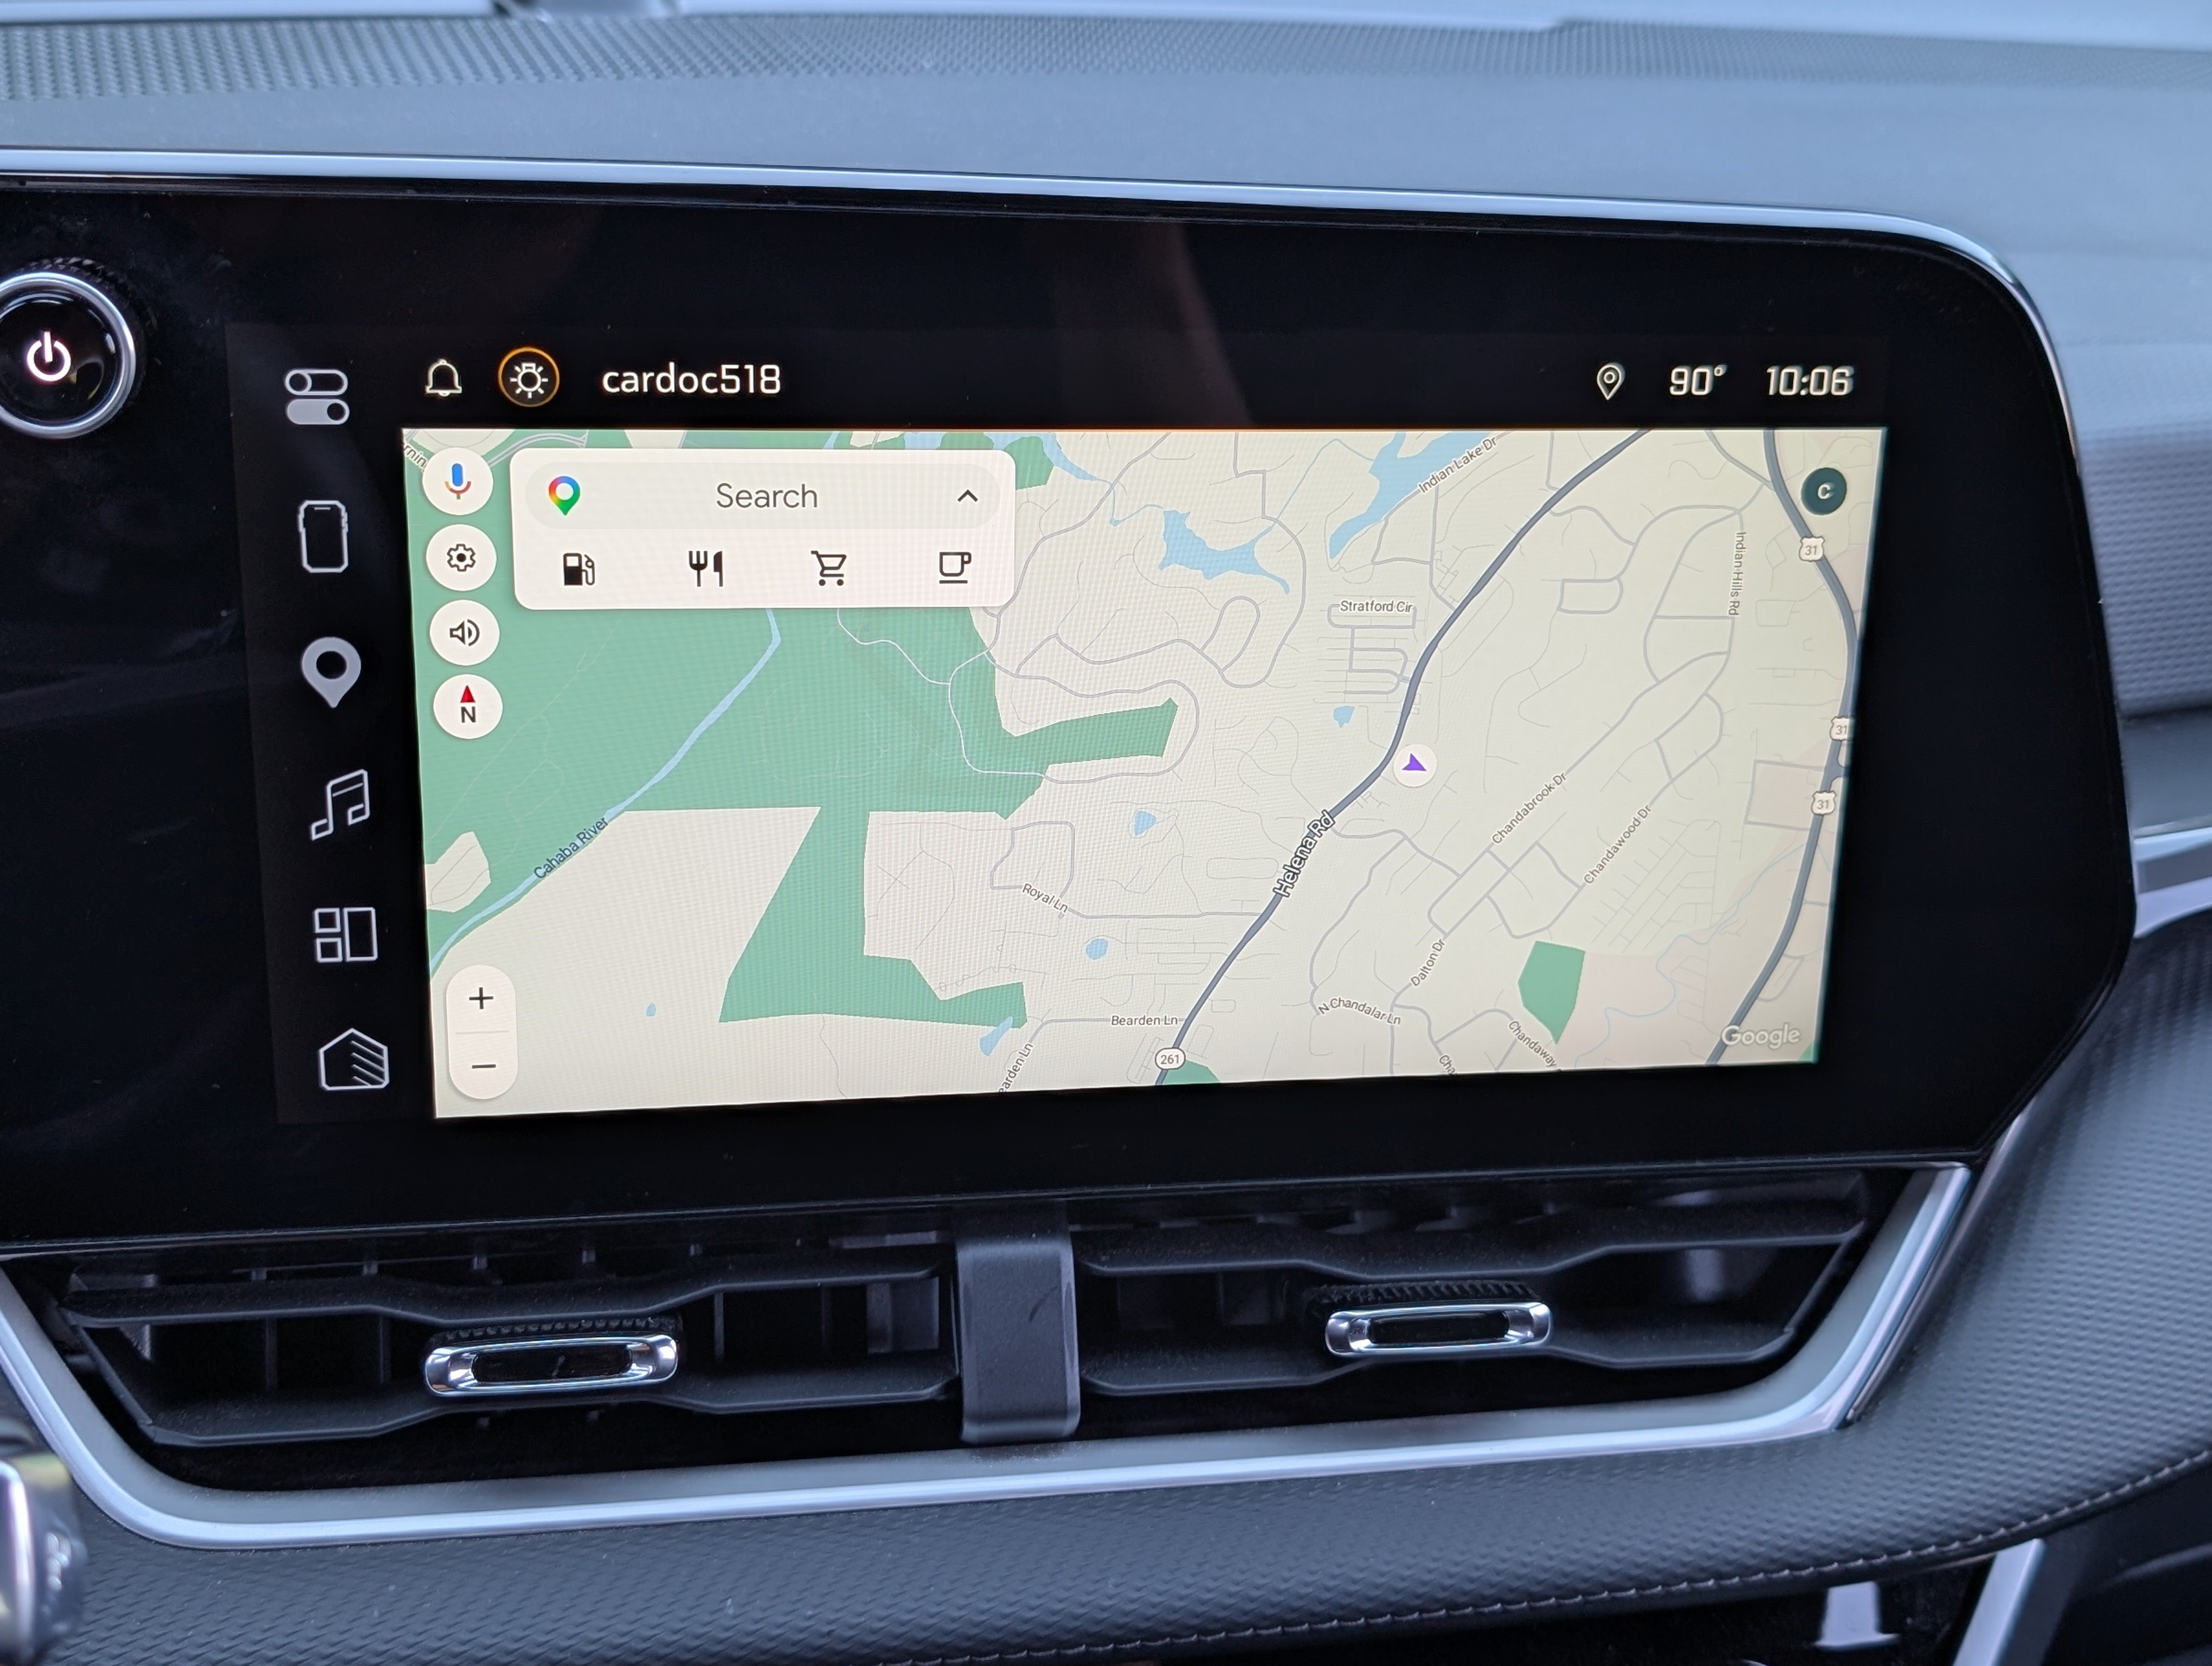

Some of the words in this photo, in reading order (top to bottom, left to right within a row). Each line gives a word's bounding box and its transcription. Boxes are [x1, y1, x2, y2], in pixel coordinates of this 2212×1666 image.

[602, 362, 781, 394] cardoc518
[1766, 365, 1854, 396] 10:06
[404, 445, 427, 472] rnin
[1418, 465, 1454, 493] Indian
[1453, 447, 1483, 470] Lake
[1482, 437, 1496, 451] Dr
[716, 483, 818, 509] Search
[1734, 532, 1746, 568] Indian
[1805, 545, 1817, 556] 31
[1731, 572, 1743, 598] Hills
[1340, 600, 1394, 612] Stratford
[1397, 601, 1413, 613] Cir
[1728, 600, 1740, 616] Rd
[460, 706, 476, 723] N
[1835, 725, 1848, 735] 31
[1492, 784, 1555, 844] Chandabrook
[1552, 773, 1566, 785] Dr
[1816, 799, 1829, 810] 31
[534, 842, 580, 879] Cahaba
[576, 817, 608, 844] River
[1272, 836, 1318, 898] Helena
[1307, 809, 1335, 838] Rd
[1584, 817, 1642, 884] Chandawood
[1637, 805, 1651, 819] Dr
[1023, 883, 1055, 905] Royal
[1053, 899, 1068, 913] Ln
[1411, 953, 1438, 986] Dalton
[1432, 939, 1445, 952] Dr
[1111, 1015, 1160, 1026] Bearden
[1164, 1015, 1178, 1026] Ln
[1318, 1003, 1330, 1015] N
[1330, 997, 1386, 1020] Chandalar
[1387, 1013, 1401, 1025] Ln
[1509, 1021, 1557, 1067] Chandaway
[1721, 1023, 1801, 1050] Google
[1018, 1043, 1034, 1058] Ln
[1160, 1054, 1180, 1065] 261
